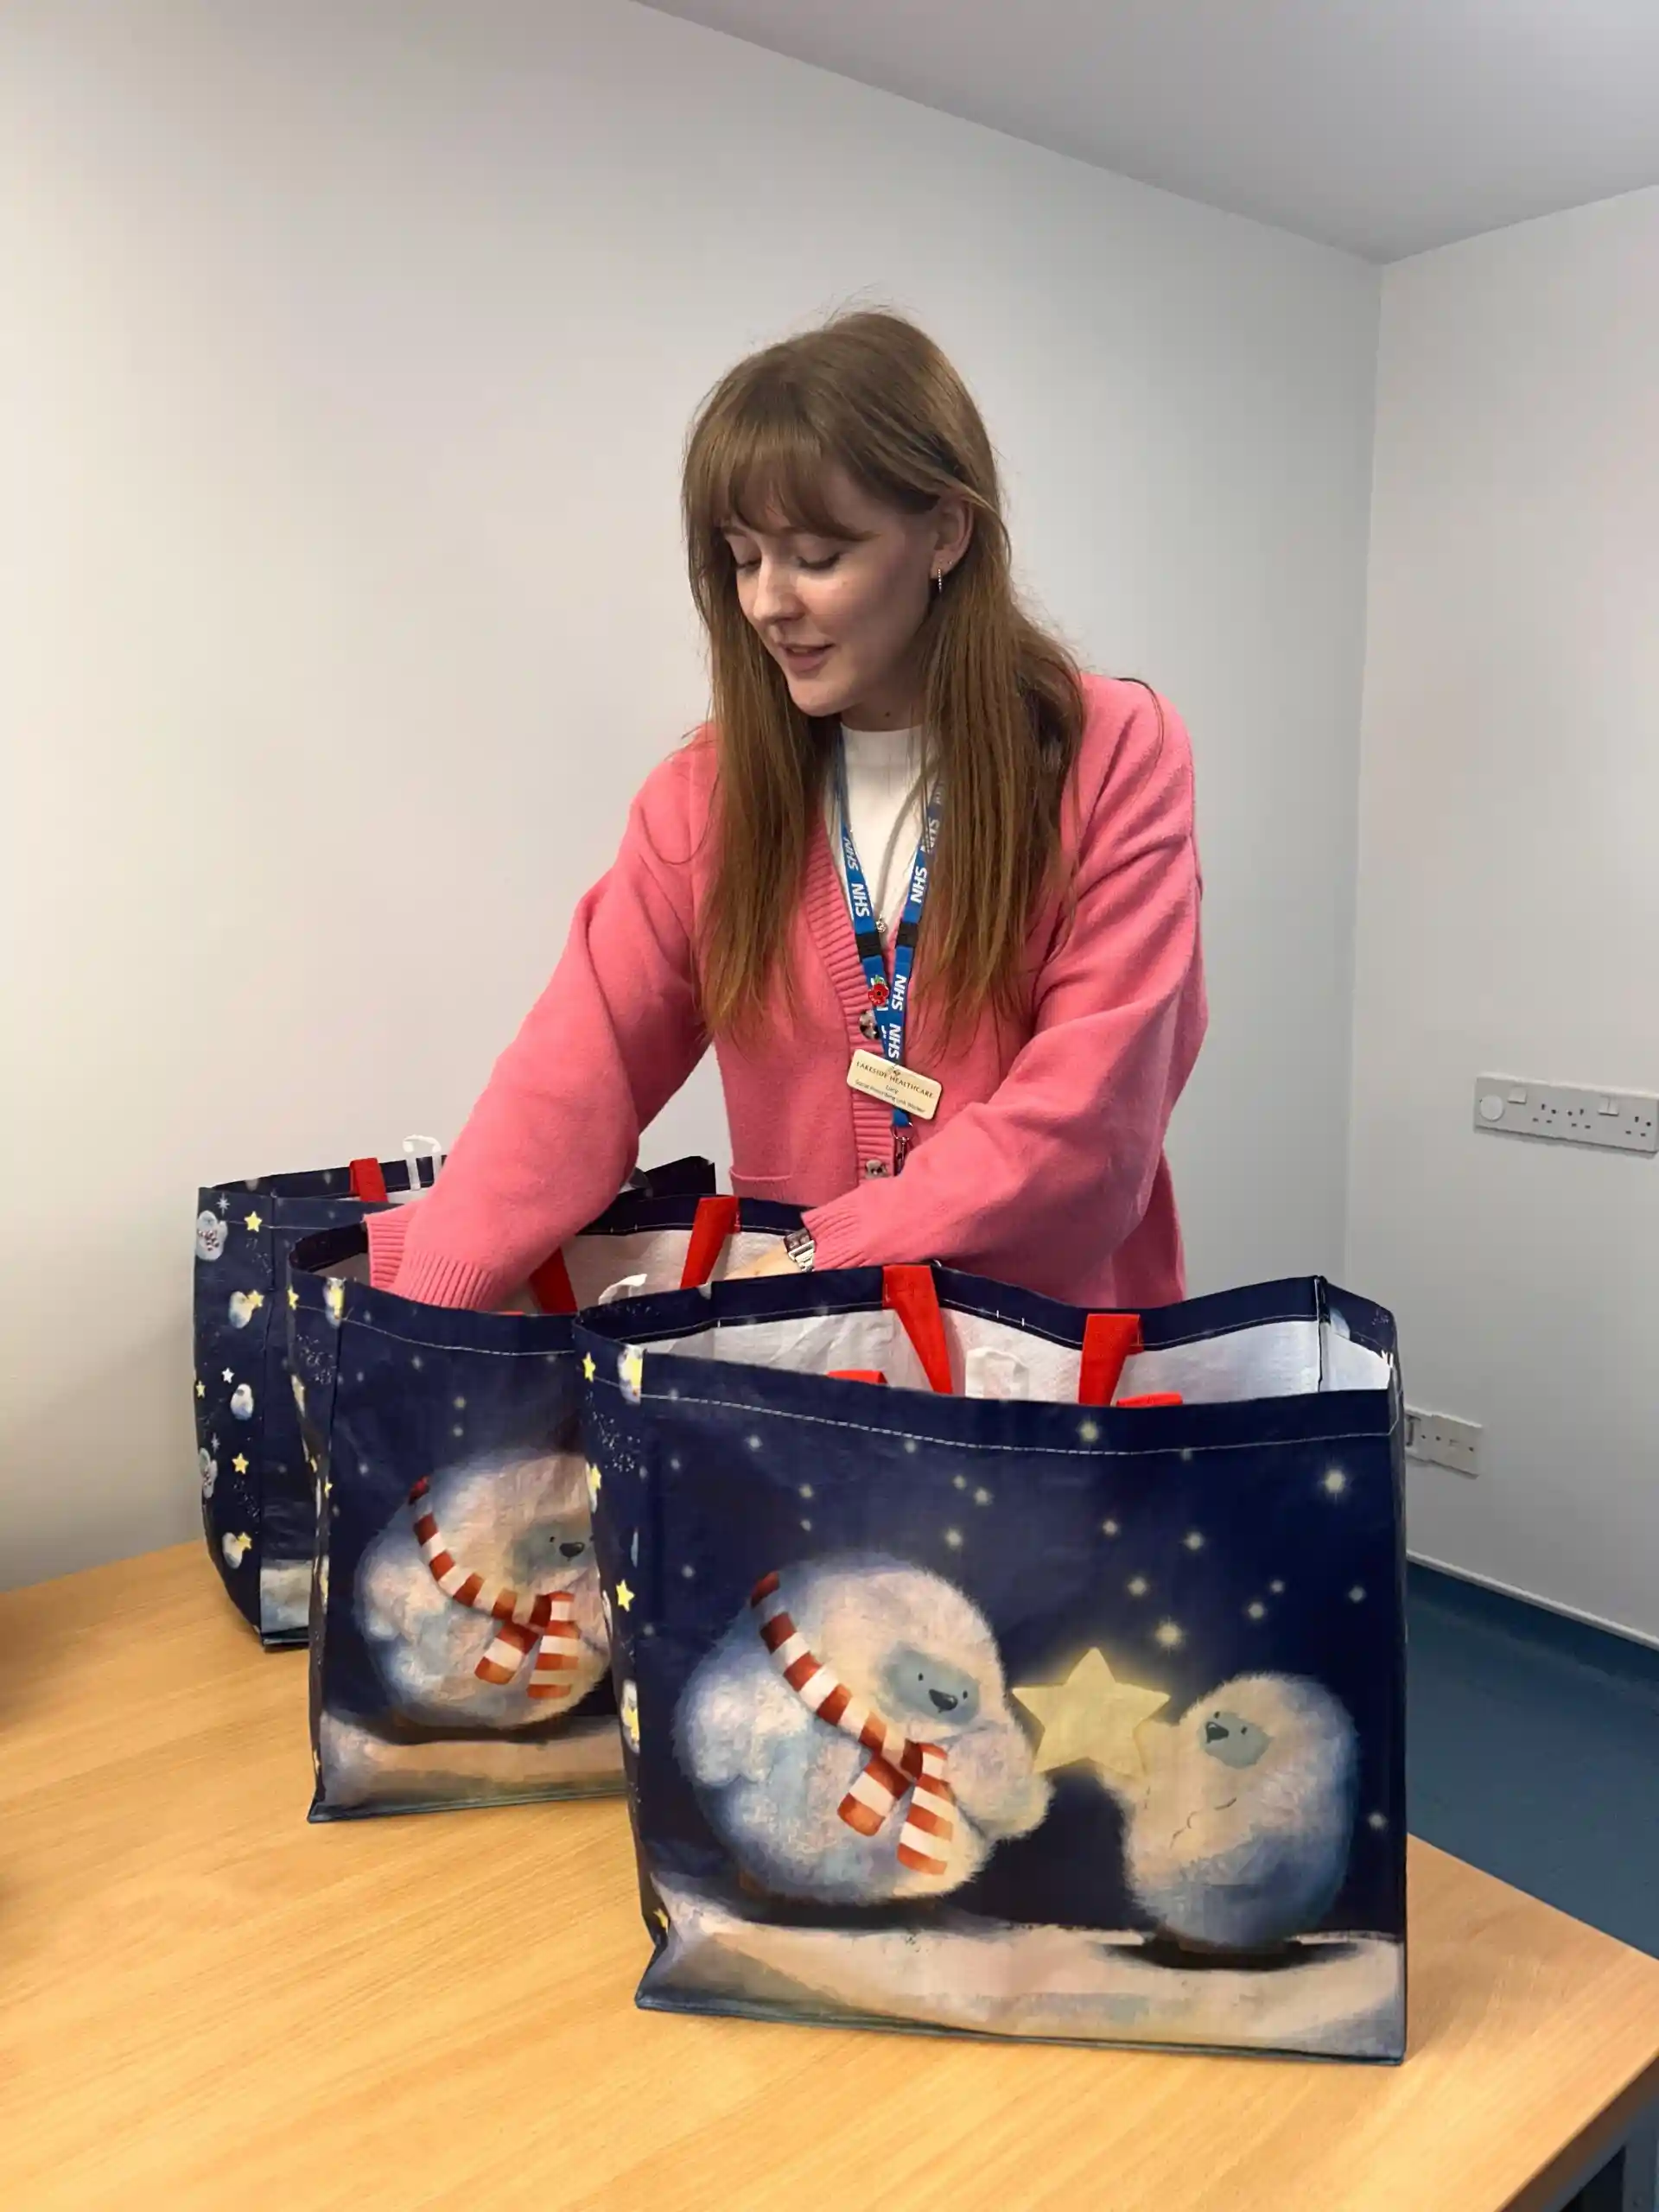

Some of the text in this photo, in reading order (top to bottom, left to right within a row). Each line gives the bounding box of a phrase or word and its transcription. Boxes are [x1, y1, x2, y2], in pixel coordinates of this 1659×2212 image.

[842, 836, 859, 871] NHS
[851, 883, 870, 917] NHS
[911, 866, 928, 903] NHS
[892, 974, 907, 1011] NHS
[888, 1023, 901, 1059] NHS
[856, 1061, 933, 1098] LAKESIDE HEALTHCARE
